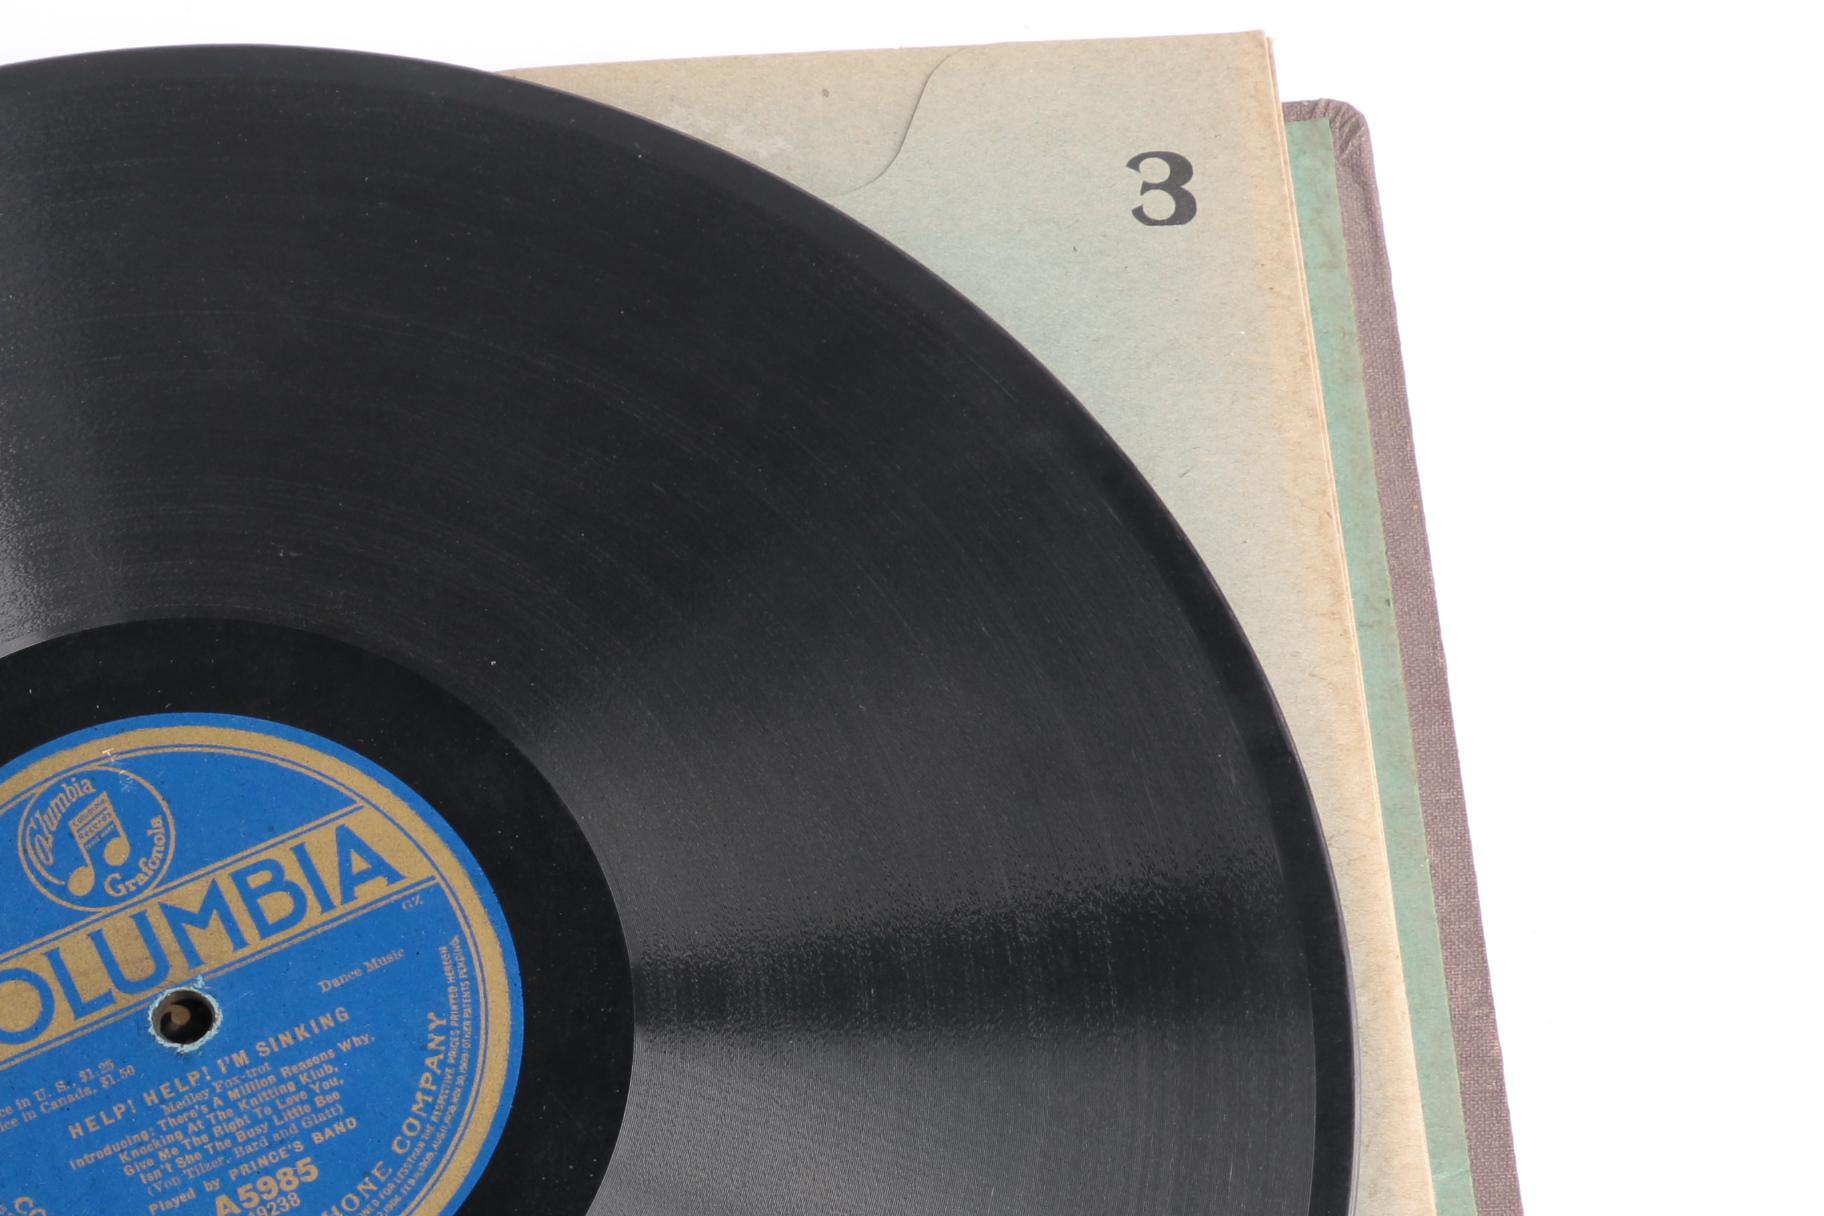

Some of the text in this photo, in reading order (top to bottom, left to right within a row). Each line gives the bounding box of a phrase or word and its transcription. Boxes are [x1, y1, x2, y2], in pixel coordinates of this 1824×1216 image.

[1125, 150, 1197, 226] 3
[103, 814, 166, 897] Grafonola
[318, 949, 403, 992] Dance Music
[15, 1098, 31, 1109] in
[22, 1110, 37, 1122] in
[39, 1086, 96, 1112] Canada,
[68, 1006, 349, 1138] HELP! HELP! I'M SINKING
[69, 1130, 154, 1169] Introducing:
[157, 1104, 208, 1130] There's
[213, 1096, 223, 1107] A
[227, 1074, 276, 1099] Million
[280, 1049, 335, 1077] Reasons
[161, 1088, 209, 1114] Medley
[391, 1011, 447, 1154] COMPANY
[119, 1130, 185, 1162] Knocking
[188, 1119, 204, 1133] At
[206, 1108, 234, 1124] The
[238, 1081, 296, 1109] Knitting
[123, 1158, 154, 1176] Give
[158, 1147, 179, 1160] Me
[180, 1134, 209, 1149] The
[212, 1115, 250, 1137] Right
[252, 1105, 272, 1118] To
[275, 1090, 307, 1109] Love
[139, 1091, 340, 1184] Isn't She The Busy Little Bee
[272, 1122, 299, 1141] and
[300, 1103, 343, 1128] Glatt)
[148, 1117, 356, 1215] Played by PRINCE'S BAND
